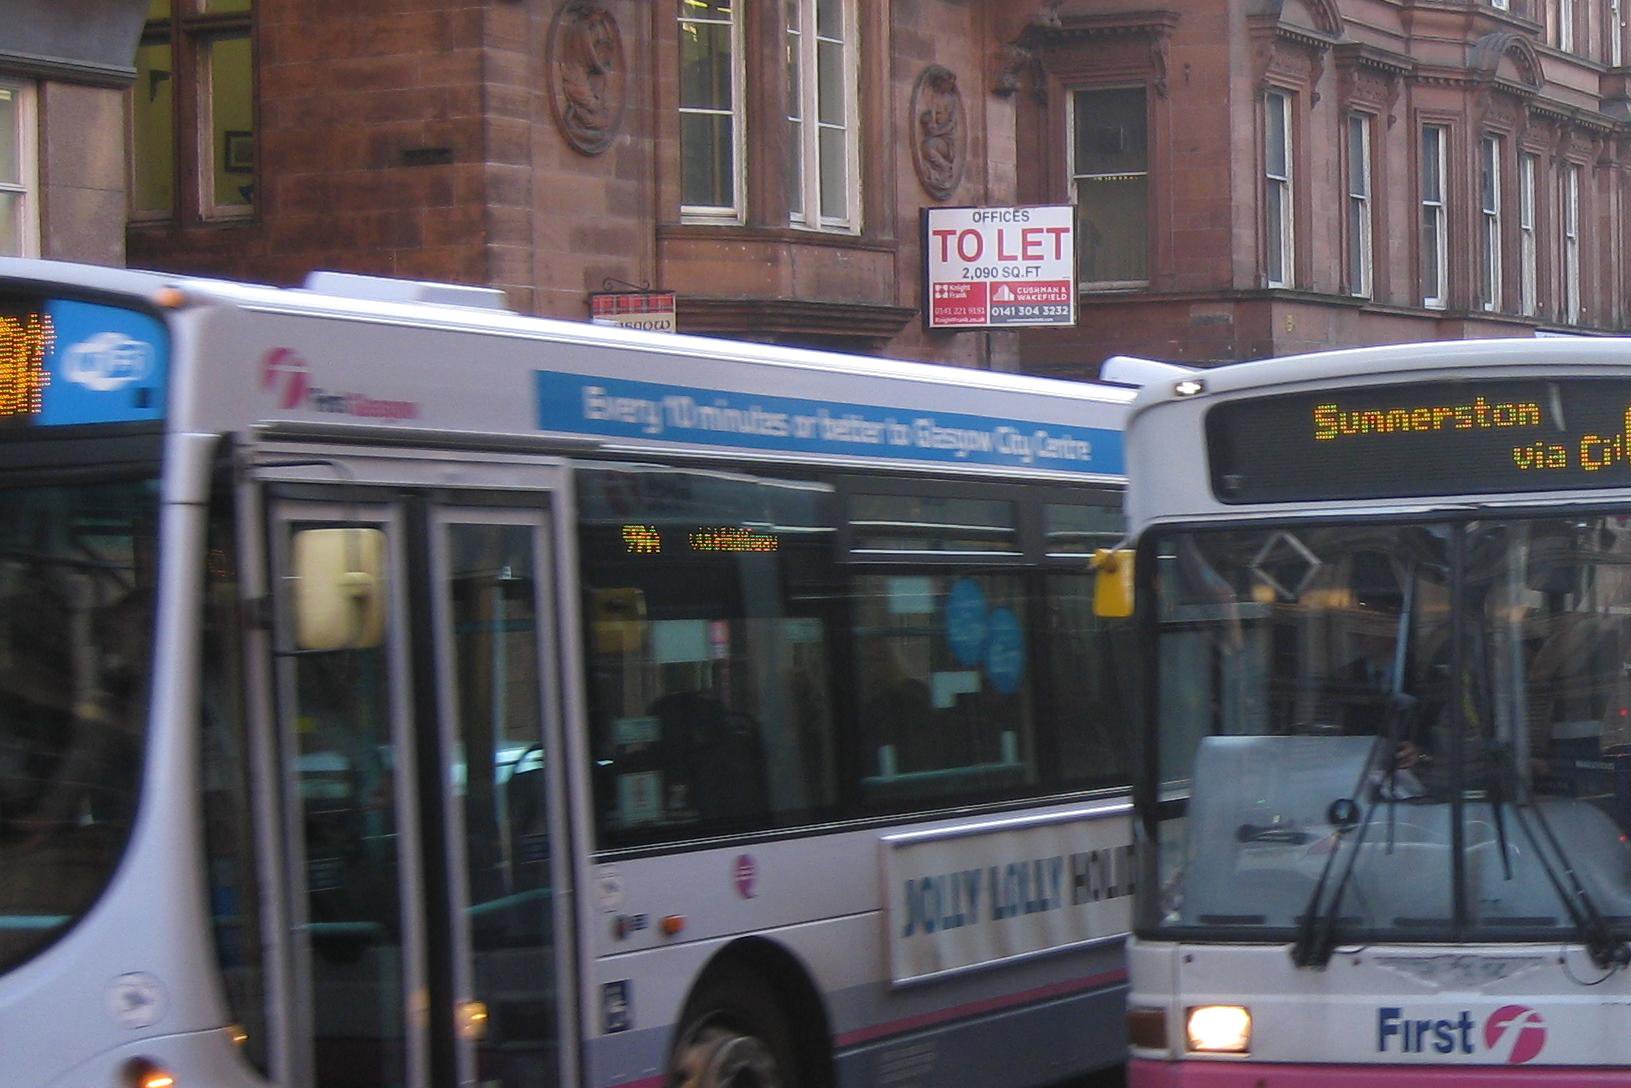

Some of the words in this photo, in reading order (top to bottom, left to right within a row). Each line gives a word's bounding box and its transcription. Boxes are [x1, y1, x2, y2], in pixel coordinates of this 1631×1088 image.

[972, 210, 1030, 223] OFFICES
[932, 228, 984, 263] TO
[997, 227, 1070, 262] LET
[962, 266, 999, 280] 2,090
[1001, 266, 1041, 278] SQ.FT
[1016, 293, 1068, 302] WAKEFIELD
[1017, 286, 1059, 294] CUSHMAN
[991, 306, 1016, 317] 0141
[1017, 306, 1040, 316] 304
[1042, 305, 1069, 316] 3232
[582, 386, 664, 433] Every
[697, 399, 789, 437] minutes
[793, 415, 817, 439] or
[816, 409, 884, 445] better
[885, 419, 910, 446] to
[912, 417, 993, 458] Glasgow
[995, 425, 1034, 463] City
[1033, 429, 1093, 461] Centre
[1313, 397, 1541, 440] Summerston
[1512, 441, 1567, 470] via
[903, 868, 983, 938] JOLLY
[1376, 1007, 1475, 1055] First
